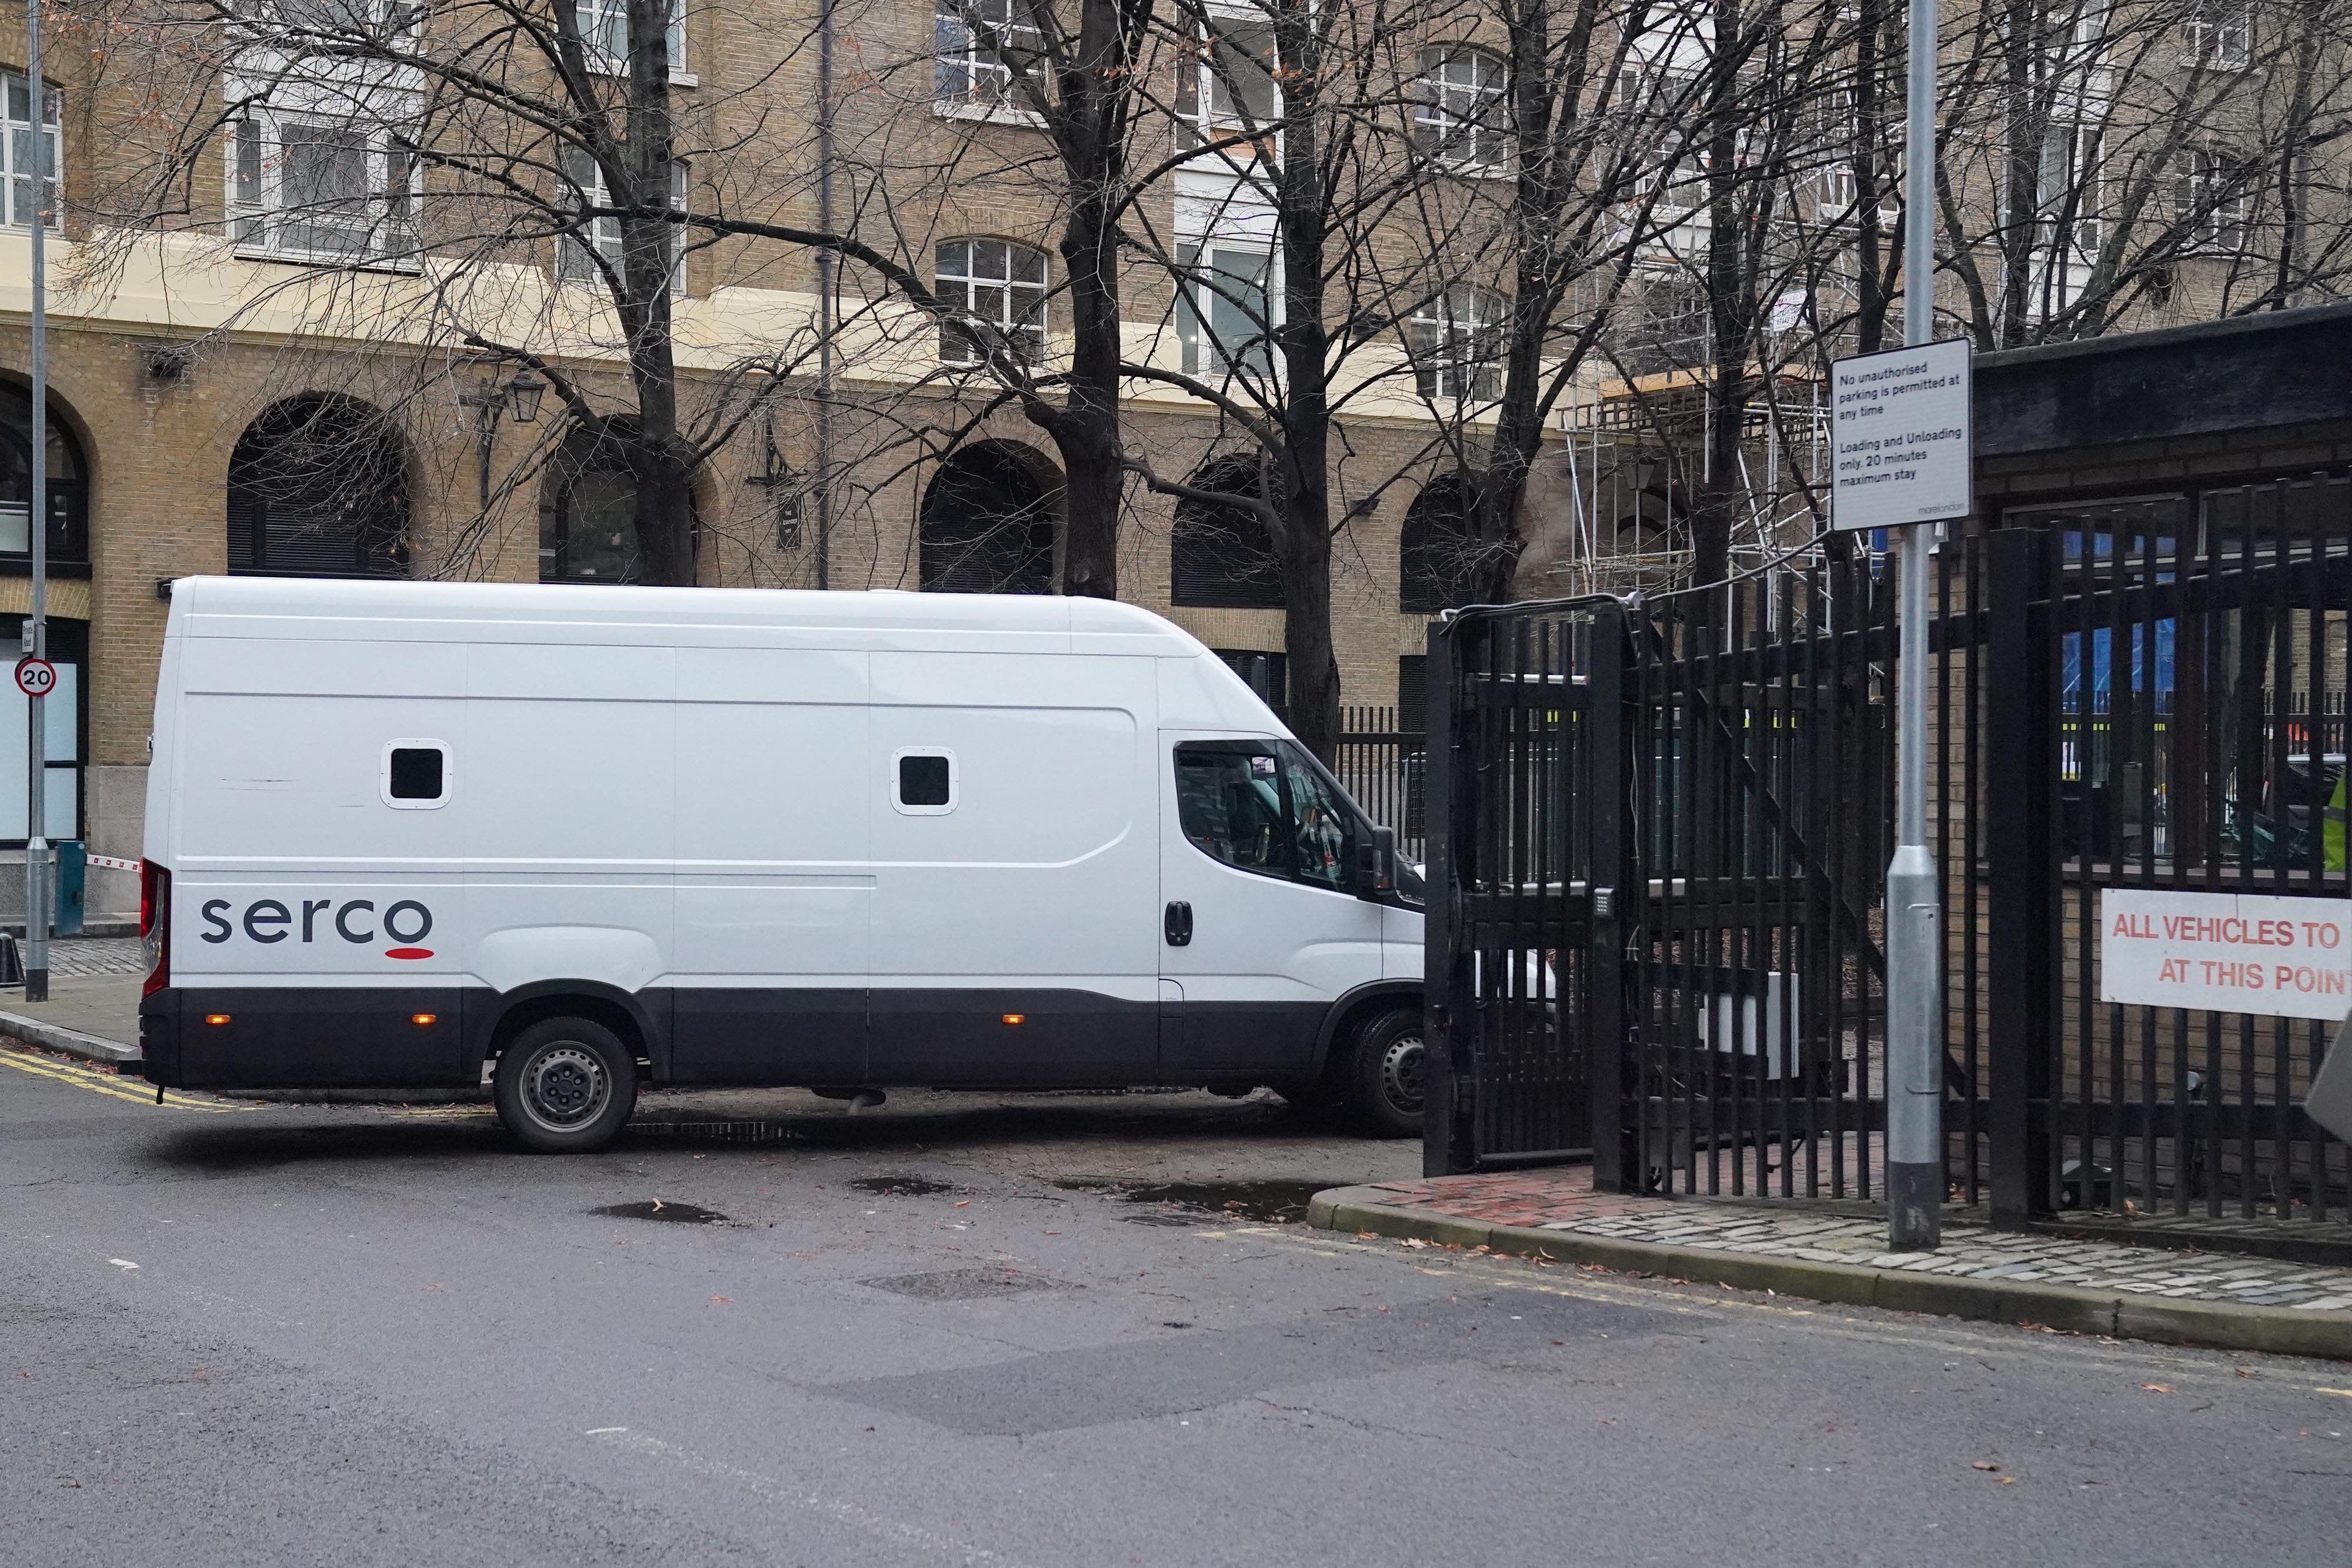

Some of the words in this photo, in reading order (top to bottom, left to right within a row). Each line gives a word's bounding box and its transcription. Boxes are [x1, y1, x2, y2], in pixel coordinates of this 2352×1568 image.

[1840, 375, 1855, 386] No
[1858, 362, 1927, 383] unauthorised
[1839, 388, 1878, 405] parking
[1882, 385, 1889, 397] is
[1892, 377, 1945, 397] permitted
[1948, 374, 1960, 386] at
[1839, 408, 1856, 420] any
[1860, 405, 1884, 417] time
[1840, 439, 1880, 454] Loading
[1883, 434, 1903, 448] and
[1907, 427, 1962, 444] Unloading
[1866, 454, 1880, 466] 20
[1884, 450, 1927, 465] minutes
[1840, 471, 1891, 487] maximum
[1895, 469, 1917, 481] stay
[24, 670, 51, 686] 20
[201, 899, 433, 944] serco
[2113, 913, 2159, 939] ALL
[2163, 915, 2294, 947] VEHICLES
[2301, 922, 2340, 949] TO
[2159, 958, 2191, 983] AT
[2200, 960, 2264, 989] THIS
